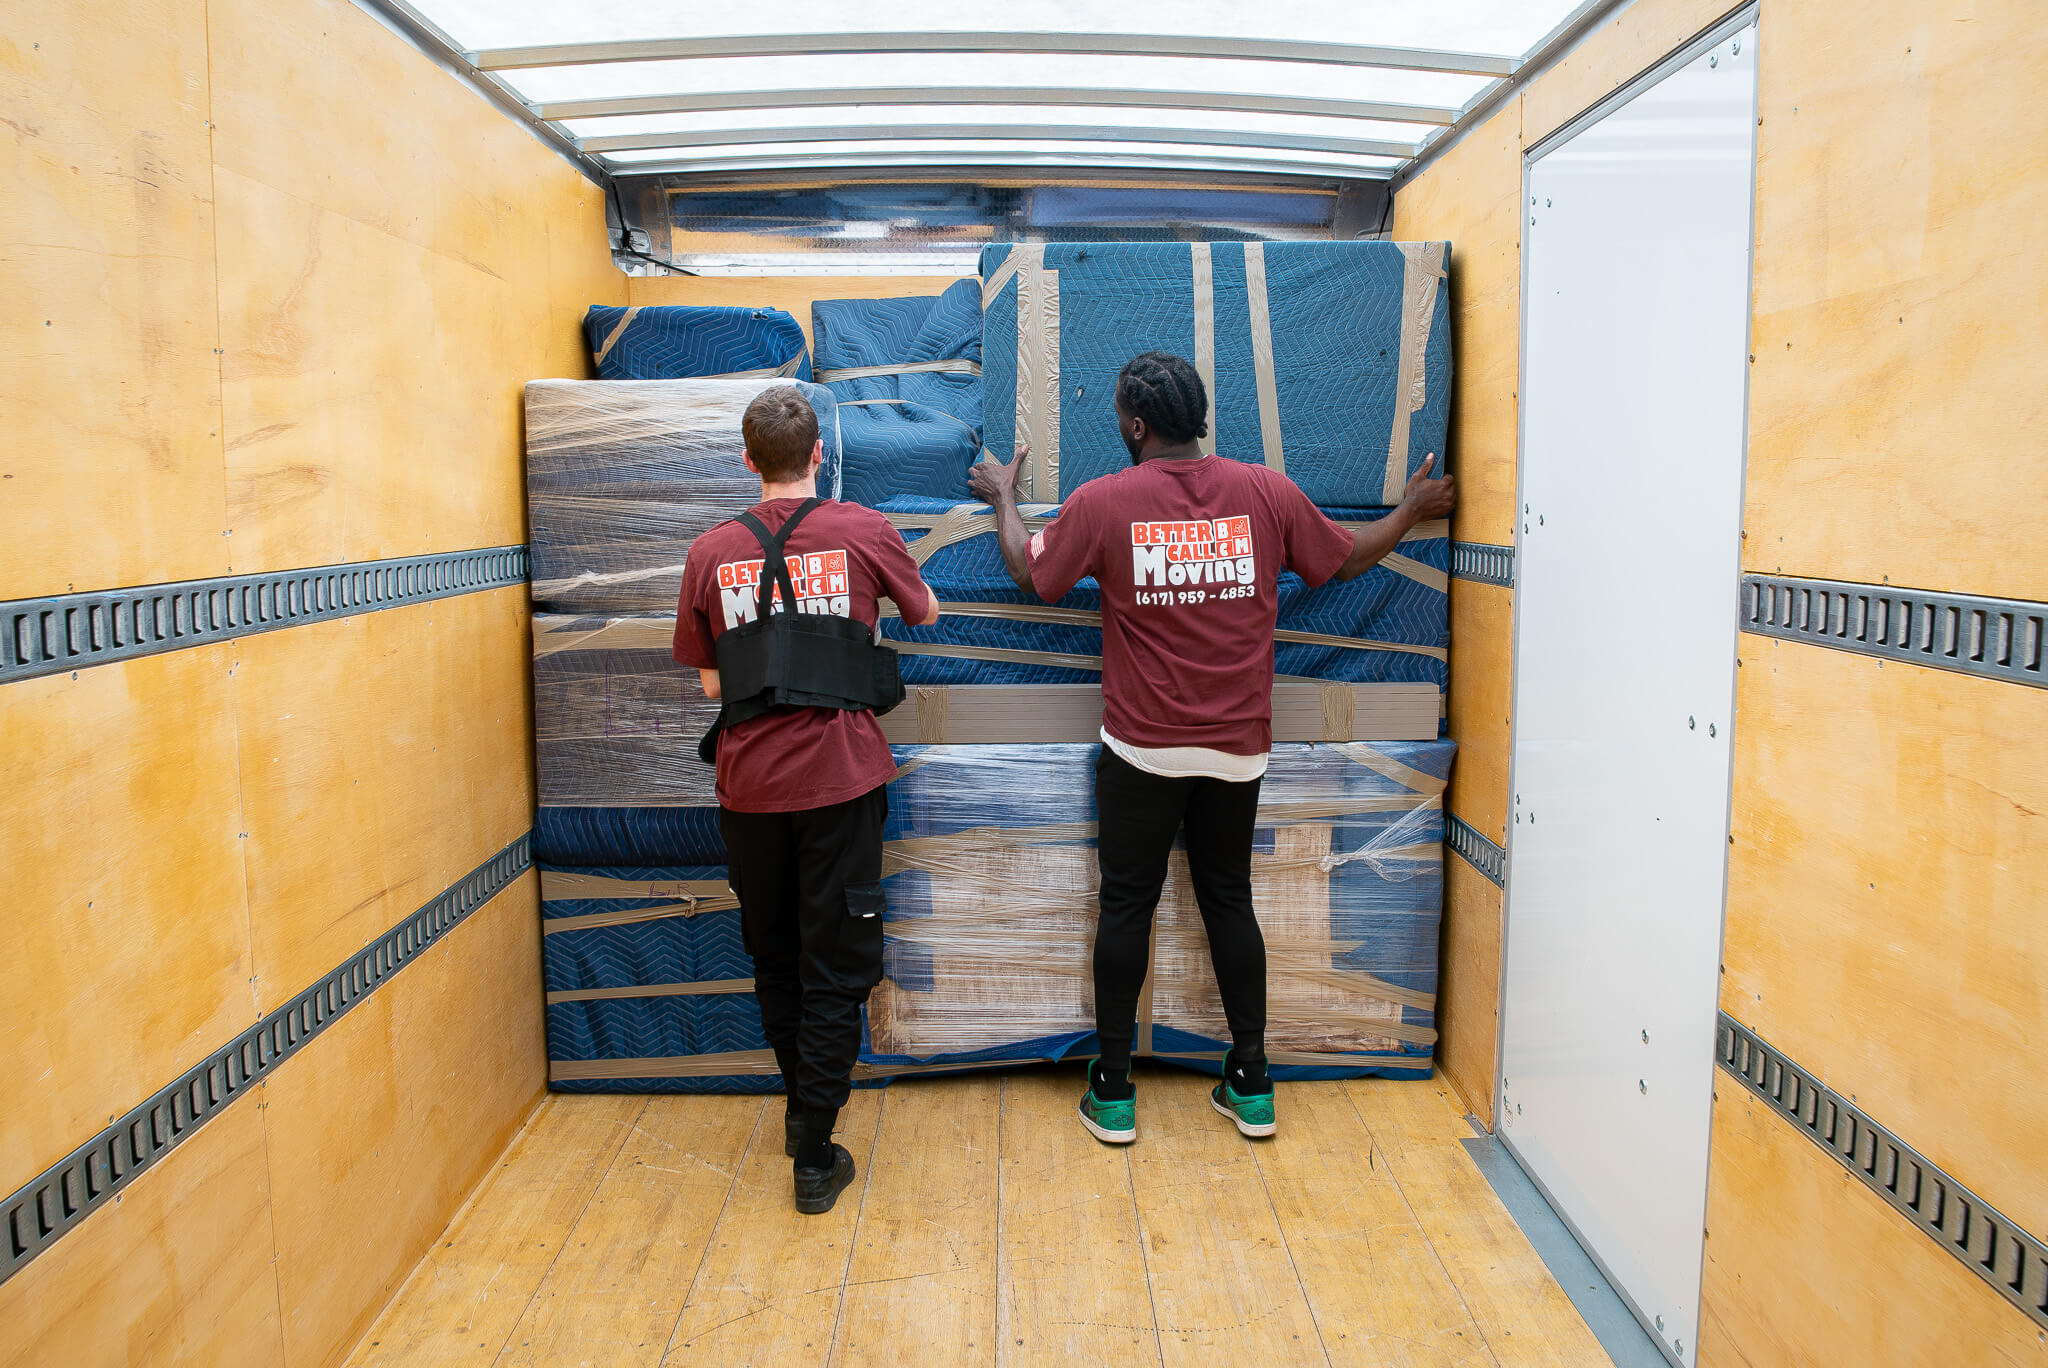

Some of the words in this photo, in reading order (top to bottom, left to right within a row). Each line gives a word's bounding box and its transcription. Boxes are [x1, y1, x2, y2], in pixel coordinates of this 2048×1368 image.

[1132, 522, 1214, 545] BETTER
[1217, 521, 1229, 540] B
[1167, 543, 1215, 562] CALL
[1219, 542, 1230, 557] C
[1234, 537, 1249, 555] M
[719, 556, 804, 588] BETR
[809, 556, 823, 576] B
[1133, 546, 1255, 586] Moving
[1136, 591, 1174, 606] (617)
[1178, 591, 1206, 604] 959
[1219, 585, 1255, 600] 4853
